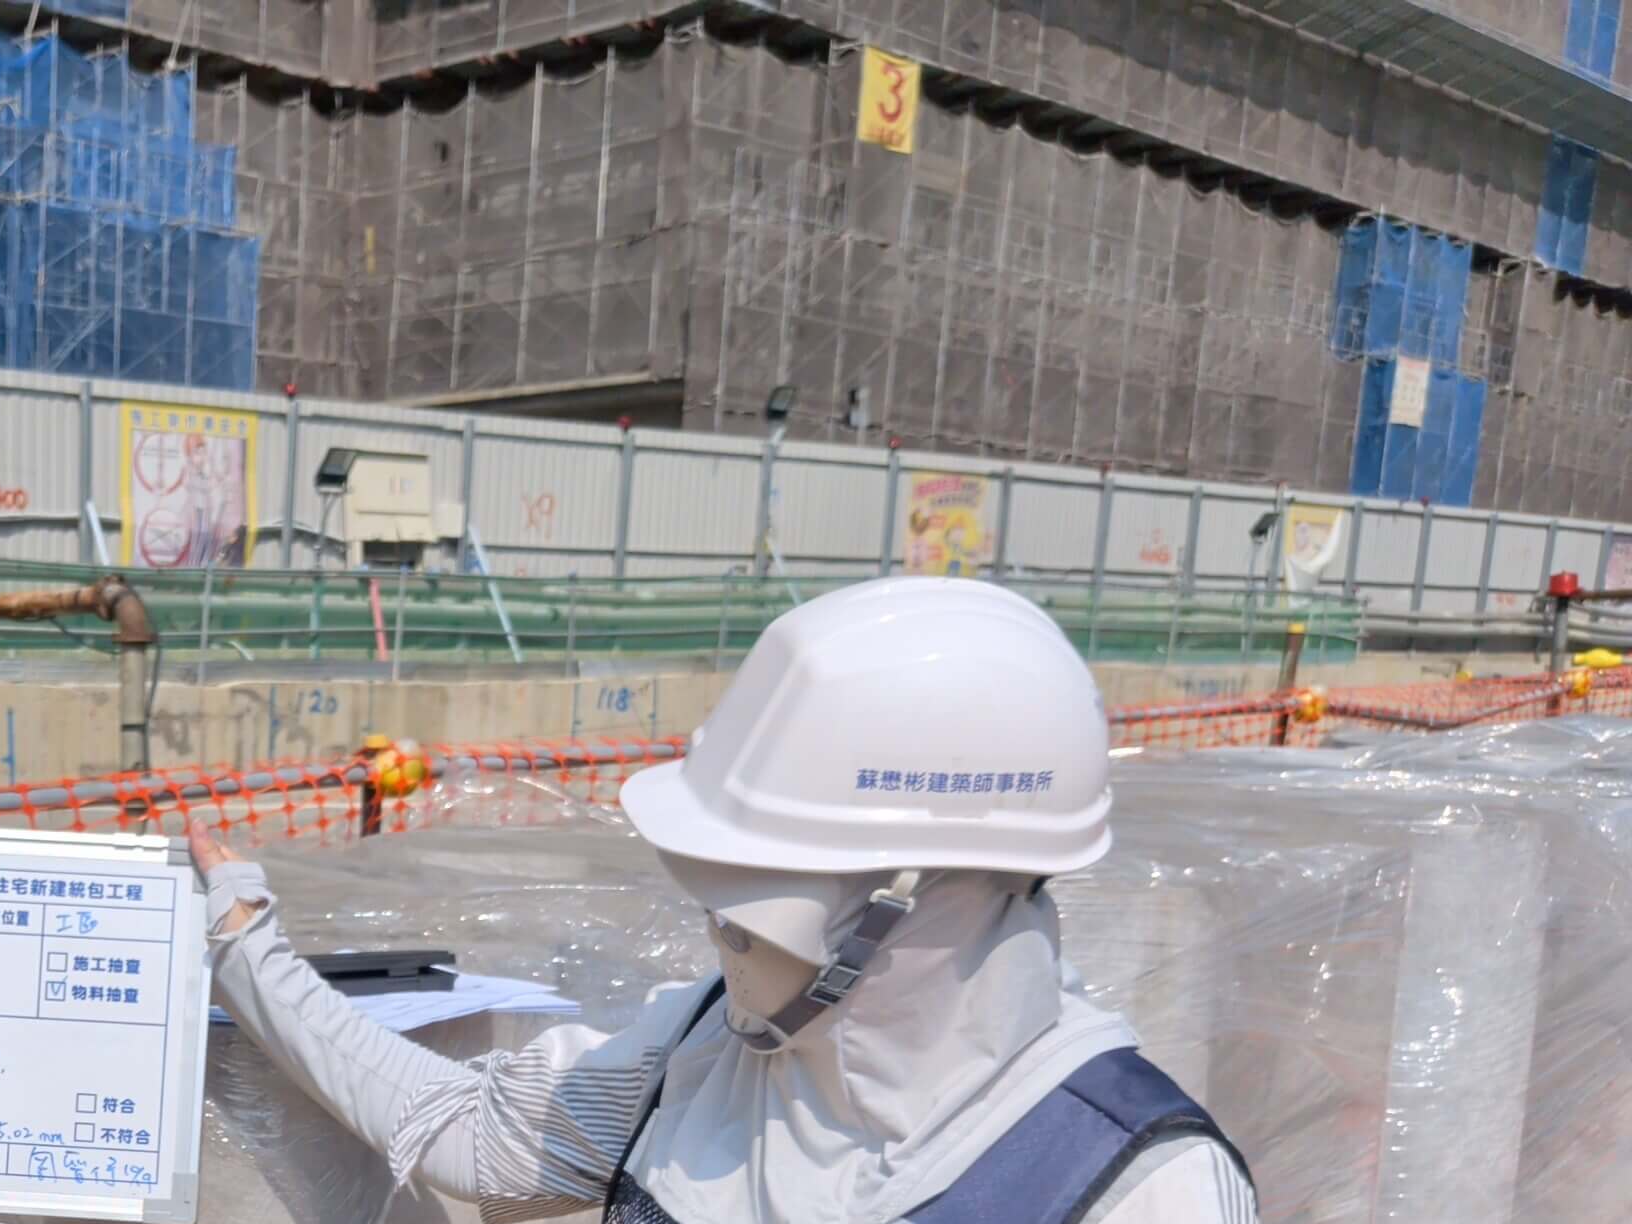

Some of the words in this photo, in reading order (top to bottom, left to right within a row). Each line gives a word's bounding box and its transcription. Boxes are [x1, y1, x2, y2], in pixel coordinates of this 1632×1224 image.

[878, 62, 903, 123] 3
[855, 768, 1055, 793] 蘇懋彬建築師事務所
[73, 956, 141, 975] 施工抽查
[71, 985, 139, 1004] 物料抽查
[102, 1097, 136, 1114] 符合
[100, 1127, 151, 1145] 不符合
